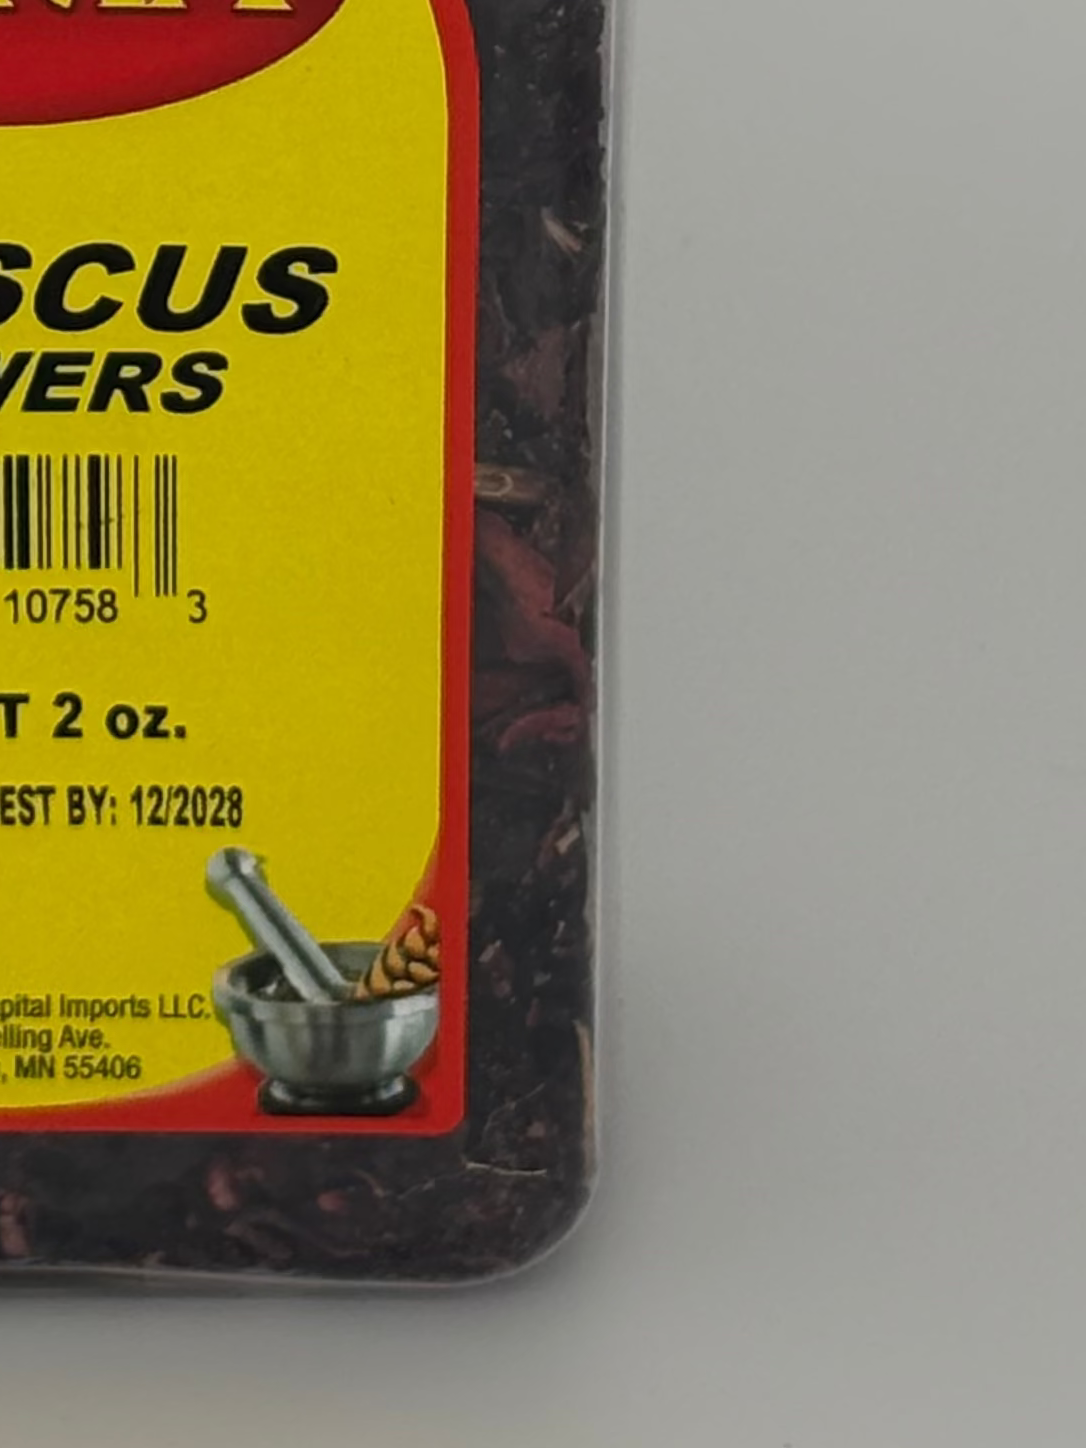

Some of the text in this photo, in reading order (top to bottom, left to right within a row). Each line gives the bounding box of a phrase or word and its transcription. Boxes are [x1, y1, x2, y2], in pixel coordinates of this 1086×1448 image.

[3, 588, 120, 624] 10758
[187, 589, 209, 624] 3
[52, 691, 84, 740] 2
[105, 703, 187, 740] oz.
[68, 785, 118, 828] BY:
[128, 784, 244, 829] 12/2028
[59, 992, 152, 1023] Imports
[158, 992, 212, 1020] LLC.
[58, 1024, 111, 1050] Ave.
[14, 1055, 56, 1079] MN
[63, 1055, 142, 1080] 55406
